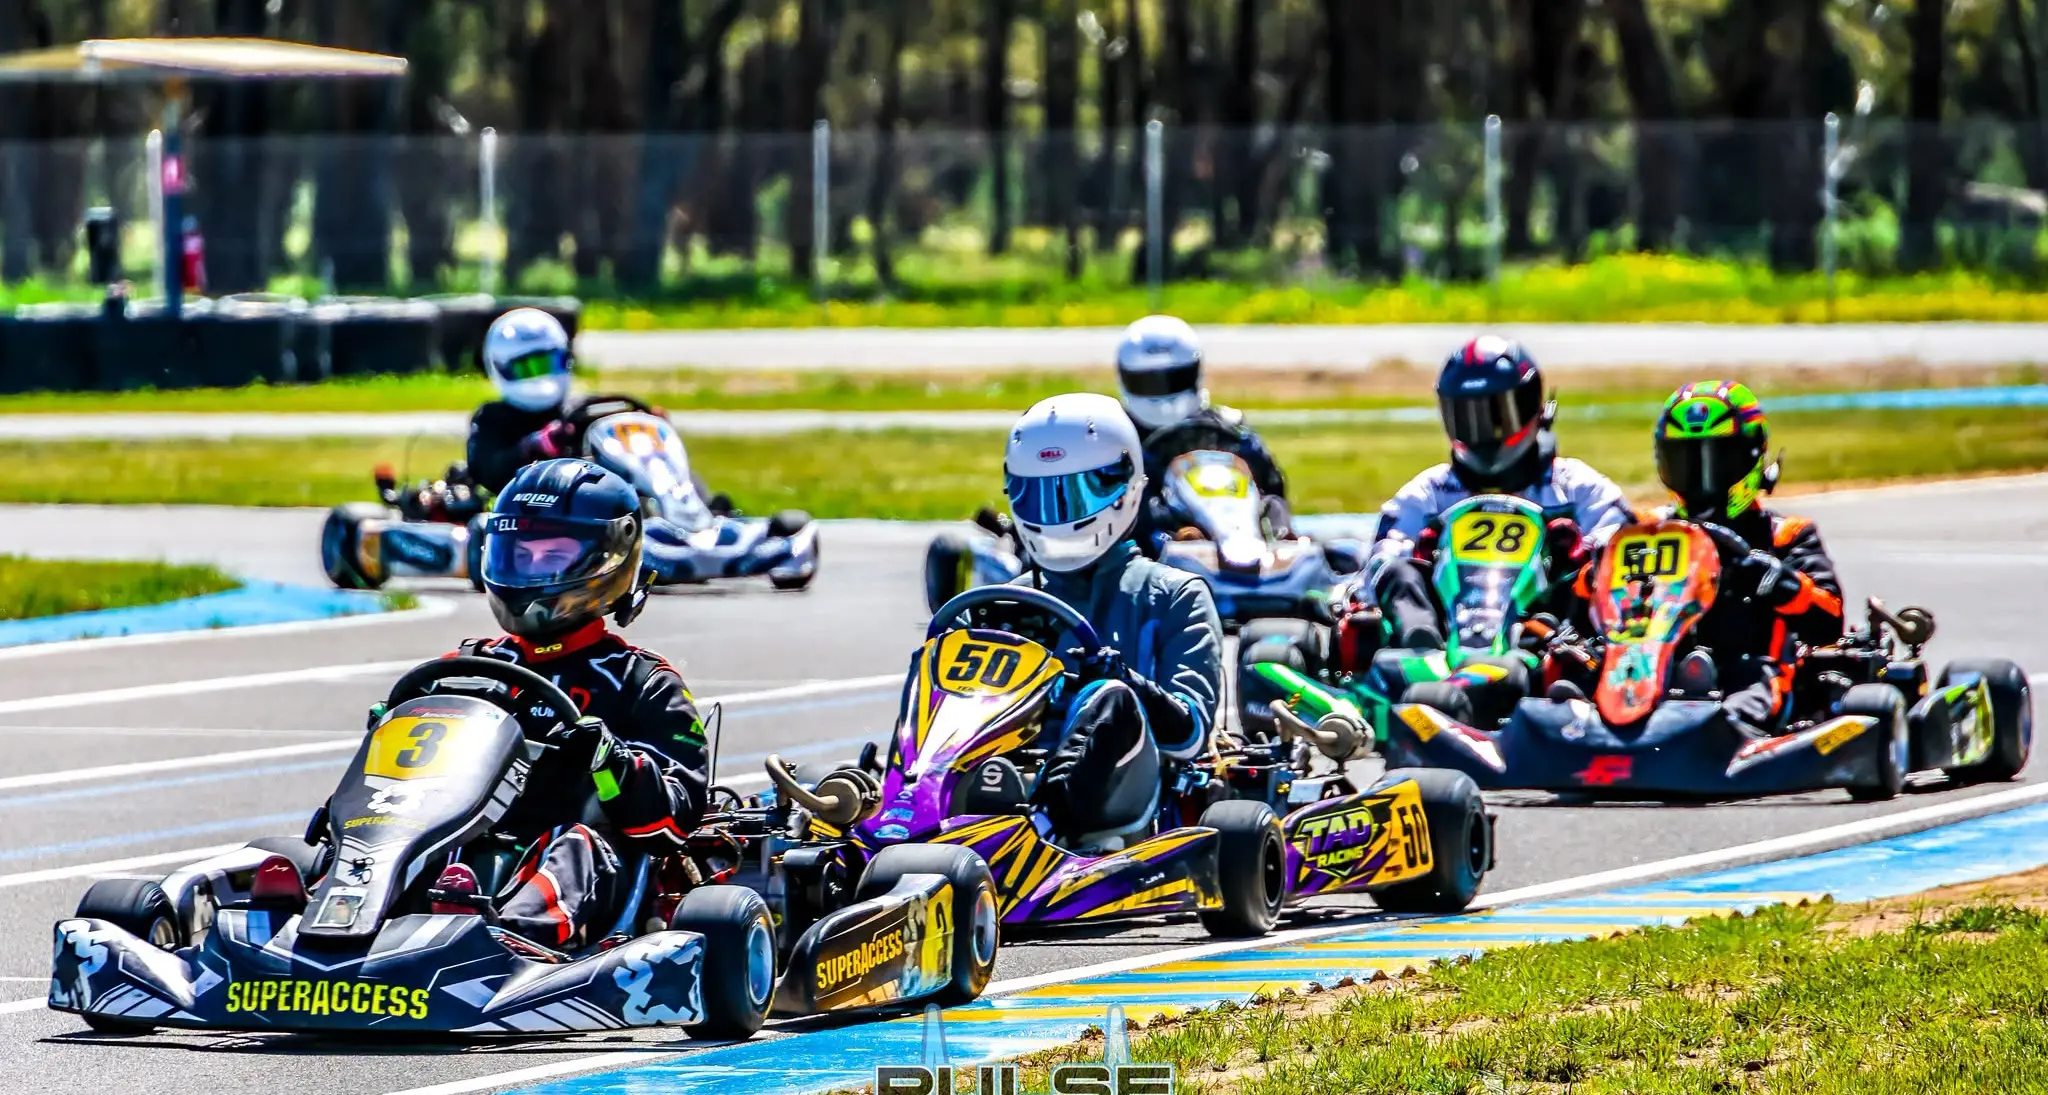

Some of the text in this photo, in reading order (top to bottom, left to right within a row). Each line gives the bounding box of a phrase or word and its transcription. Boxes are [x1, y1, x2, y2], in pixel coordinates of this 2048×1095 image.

[512, 492, 560, 506] NOLAN
[1463, 519, 1526, 553] 28
[946, 643, 1021, 688] 50
[395, 722, 448, 768] 3
[1303, 811, 1371, 854] TAD
[1397, 804, 1429, 868] 50
[1317, 847, 1363, 868] RACING
[815, 929, 904, 989] SUPERACCESS
[225, 980, 430, 1020] SUPERACCESS
